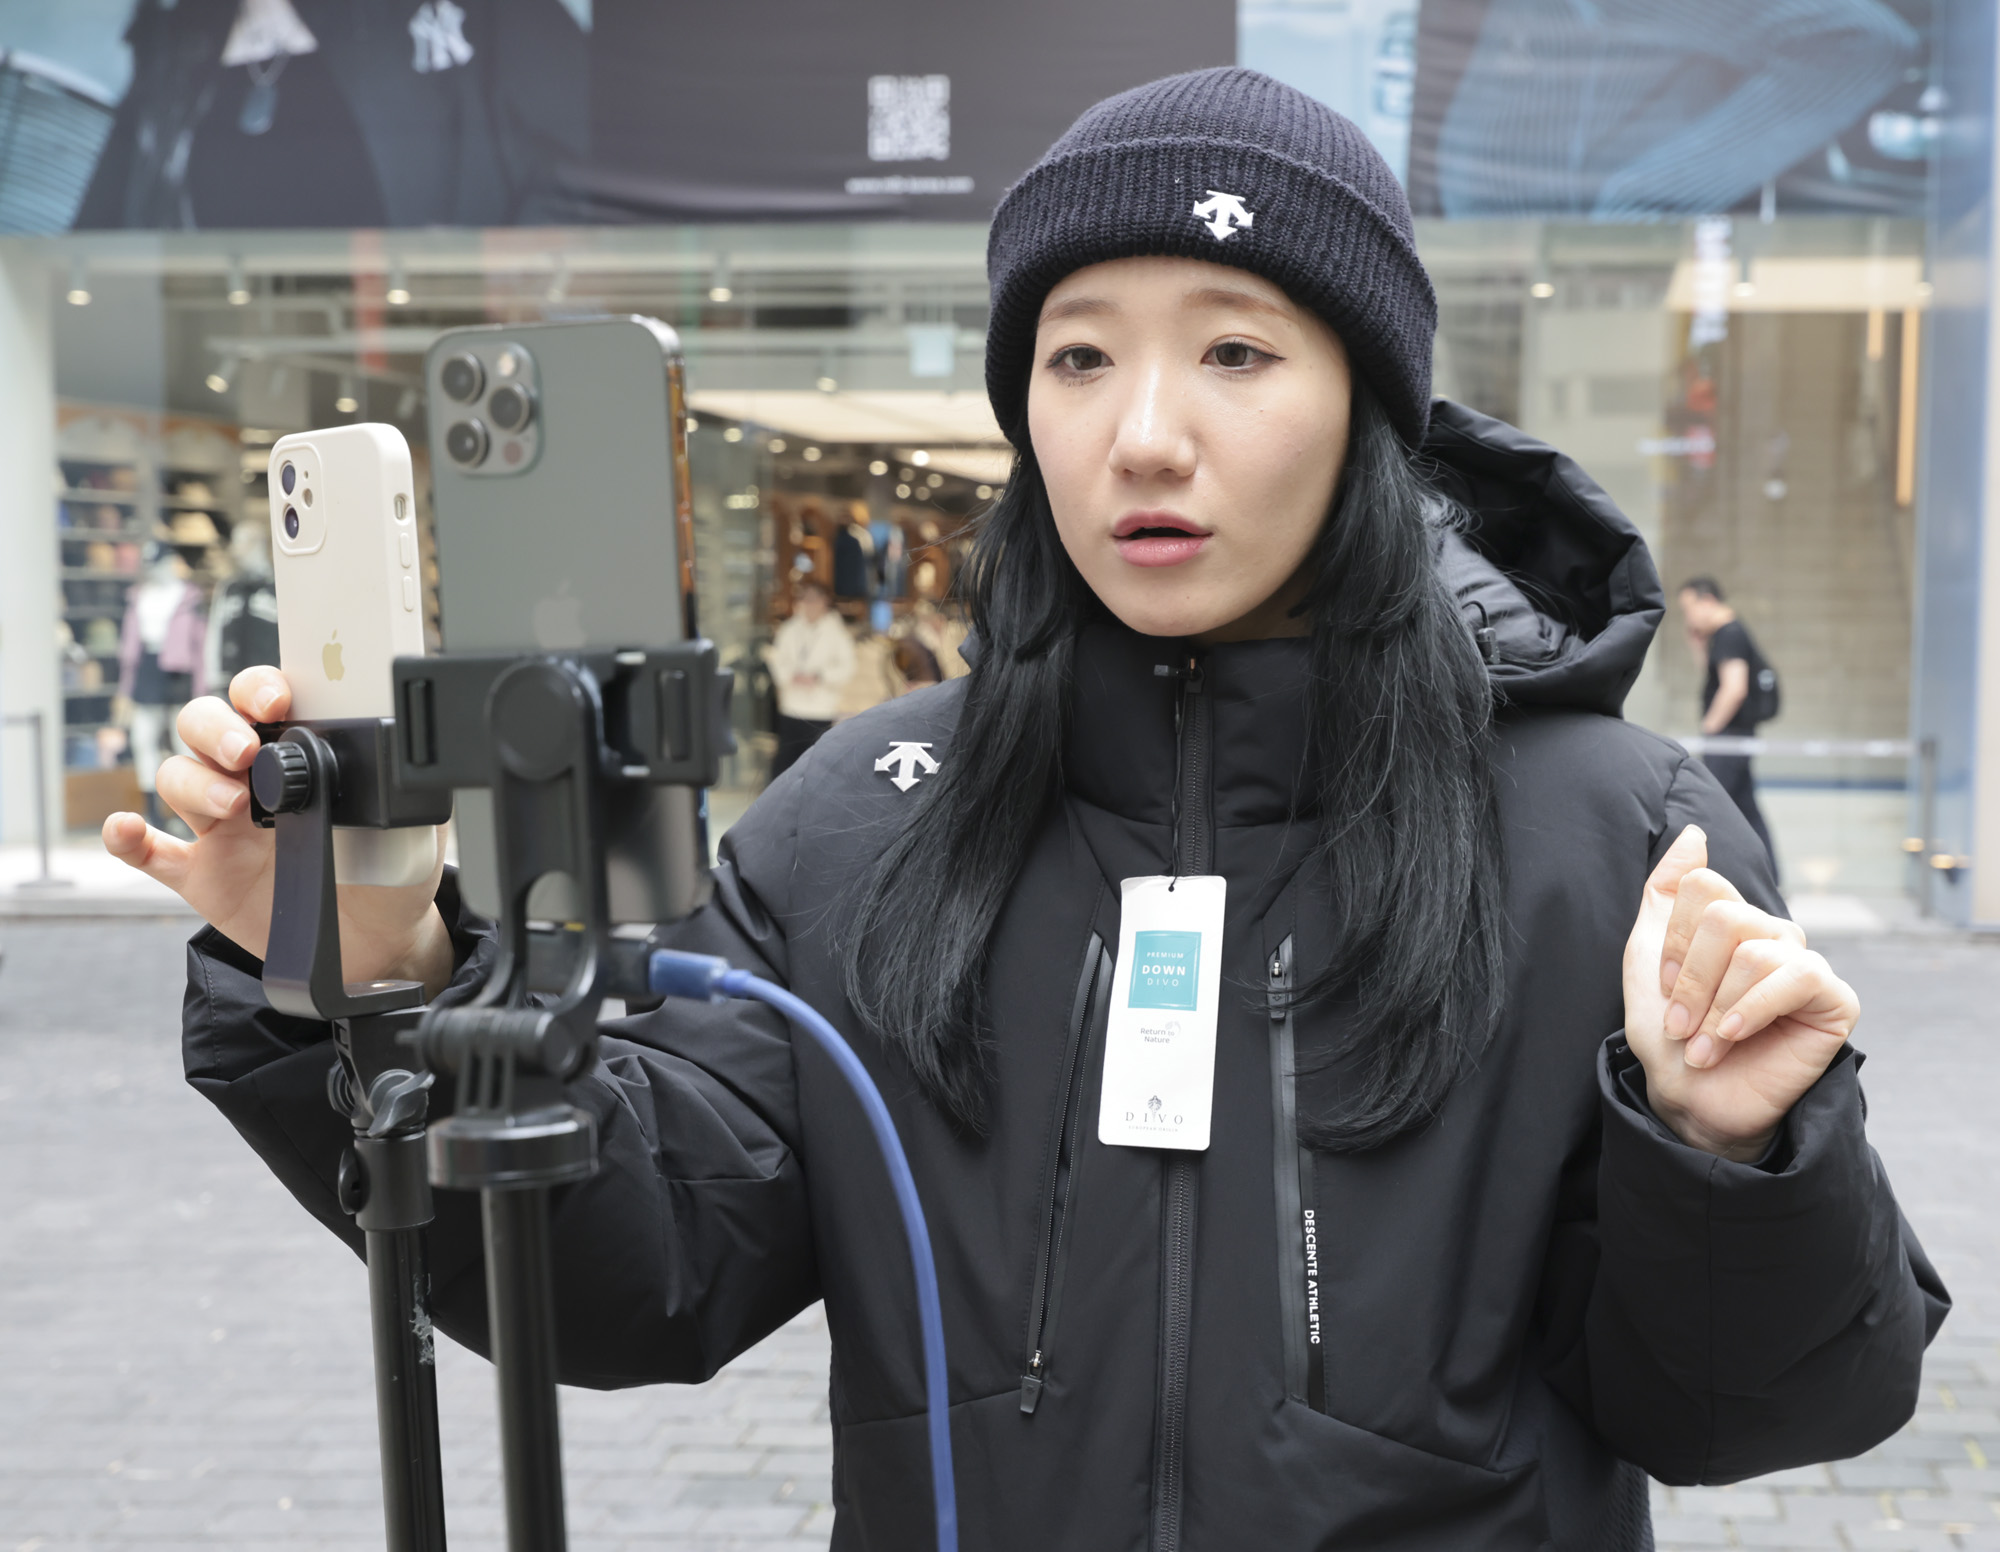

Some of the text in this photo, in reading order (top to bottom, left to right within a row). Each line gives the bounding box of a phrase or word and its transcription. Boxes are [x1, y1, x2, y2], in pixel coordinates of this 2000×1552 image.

[1146, 951, 1184, 959] PREMIUM
[1142, 964, 1186, 976] DOWN
[1146, 978, 1180, 987] DIVO
[1140, 1027, 1166, 1036] Return
[1144, 1036, 1171, 1044] Nature
[1125, 1111, 1184, 1125] DIVO
[1304, 1209, 1320, 1344] DESCENTE ATHLETIC
